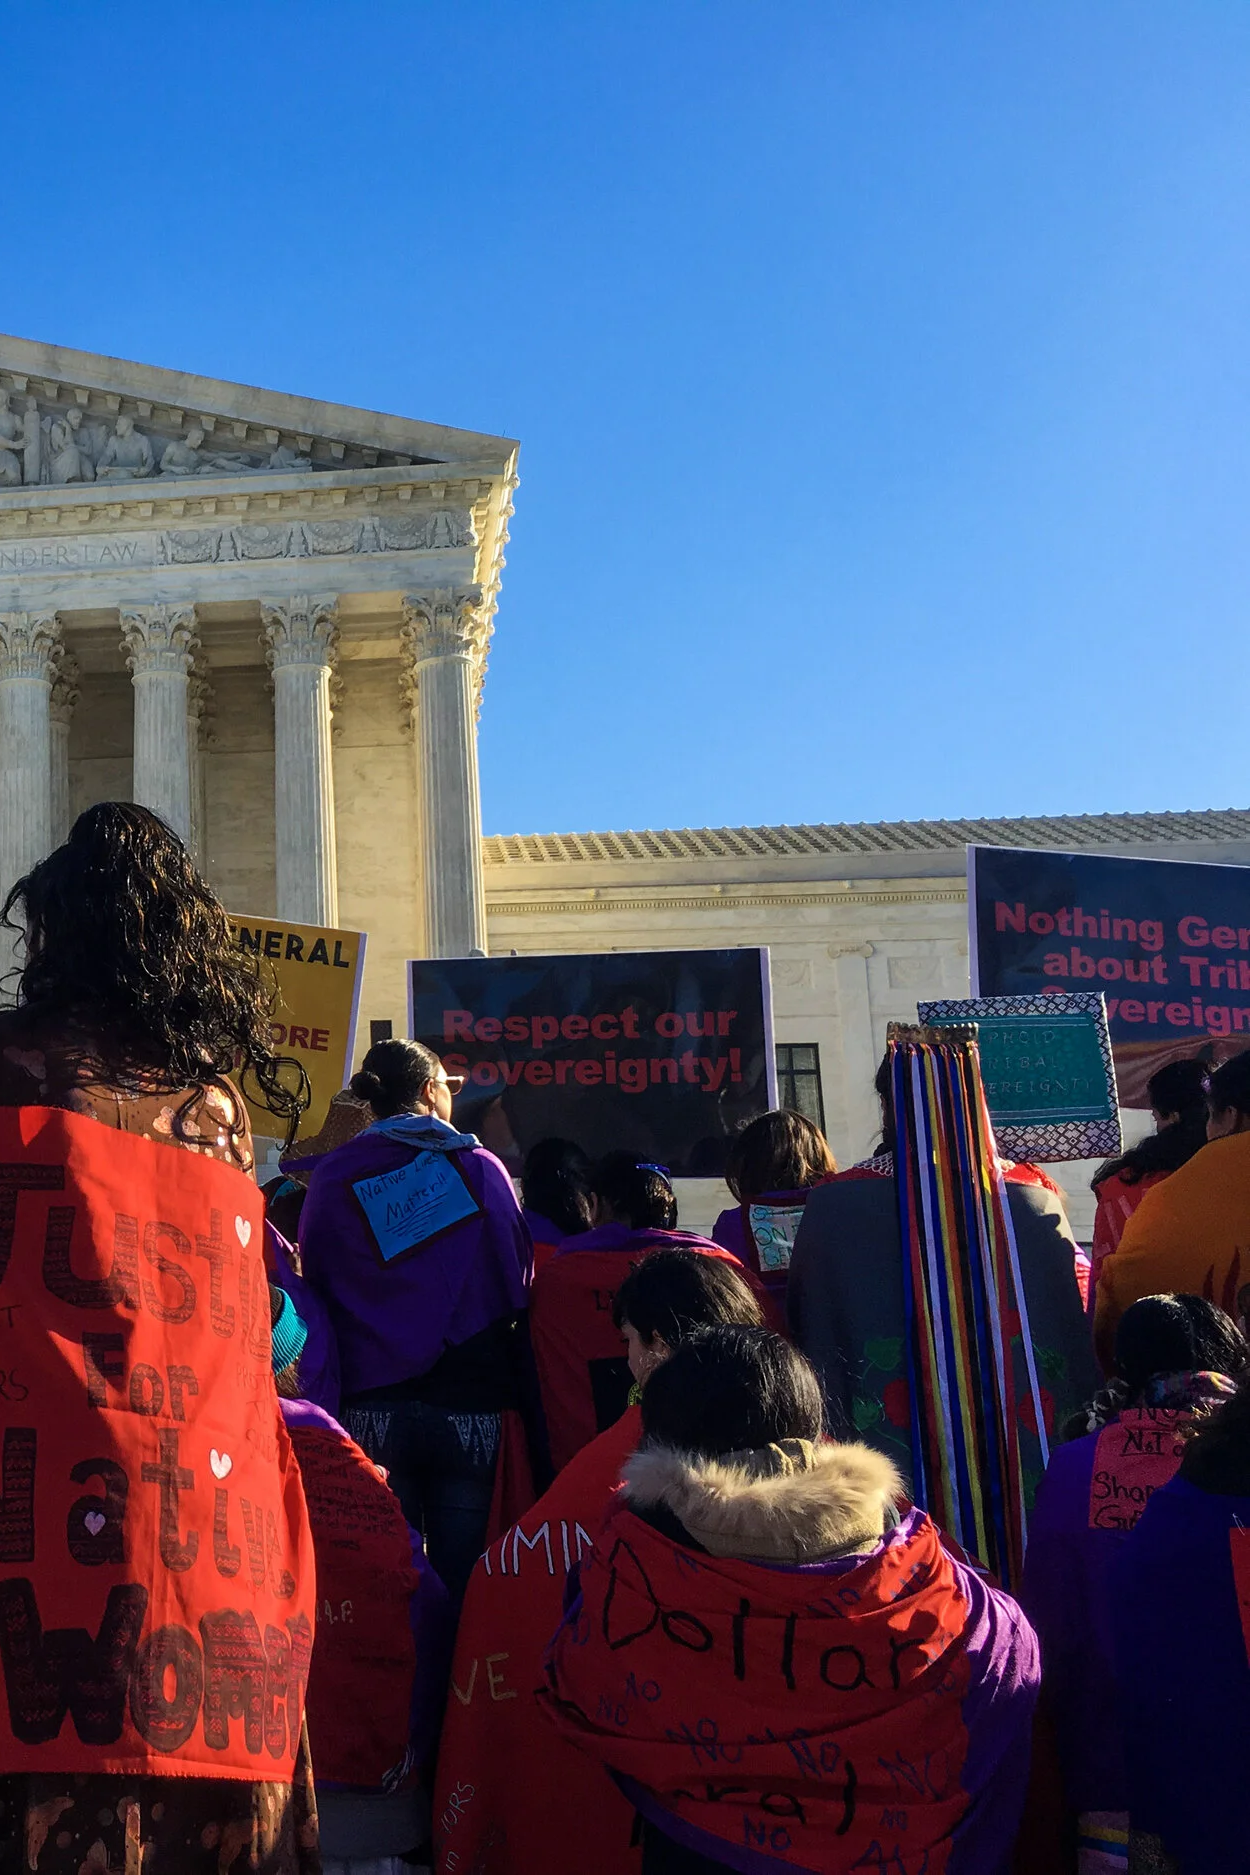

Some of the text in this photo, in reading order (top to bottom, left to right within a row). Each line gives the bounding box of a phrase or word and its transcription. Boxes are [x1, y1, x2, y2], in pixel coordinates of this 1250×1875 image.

[85, 541, 139, 564] LAW
[994, 900, 1165, 952] Nothing
[230, 926, 350, 969] NERAL
[1042, 947, 1169, 985] about
[268, 1022, 331, 1052] ORE
[442, 1004, 738, 1049] Respect our
[986, 1030, 1056, 1045] PHOLD
[440, 1047, 742, 1093] Sovereignty!
[359, 1169, 407, 1203] Native
[602, 1537, 926, 1692] Dollar
[625, 1671, 662, 1702] NO
[787, 1740, 841, 1779] NO
[742, 1812, 793, 1851] NO
